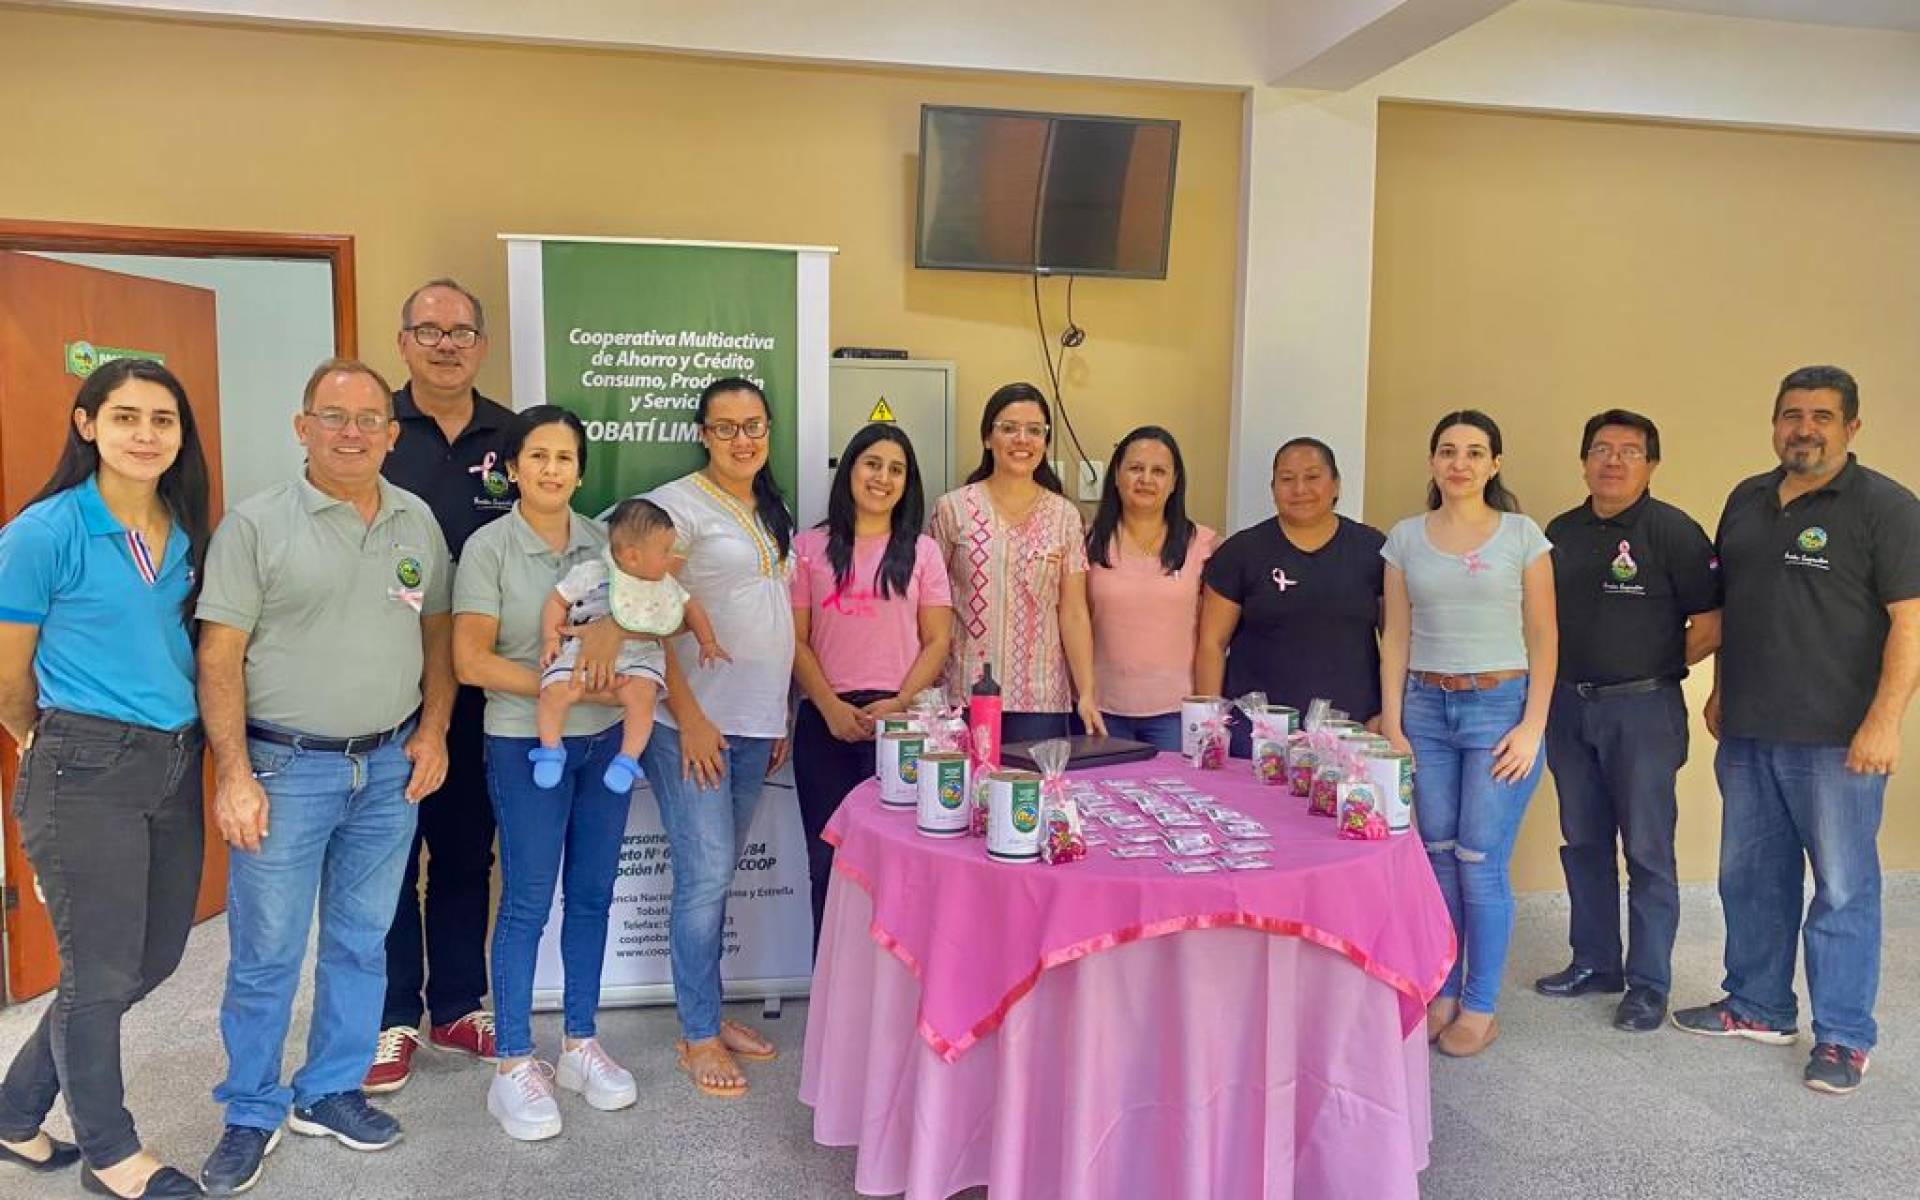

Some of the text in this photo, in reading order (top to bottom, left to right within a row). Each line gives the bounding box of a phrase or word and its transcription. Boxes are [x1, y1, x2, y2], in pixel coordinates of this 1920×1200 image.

[569, 327, 775, 350] Cooperativa Multiactiva
[591, 350, 755, 372] de Ahorro y Crédito
[582, 370, 667, 391] Consumo,
[629, 394, 642, 413] y
[580, 417, 704, 444] OBATÍ LIM
